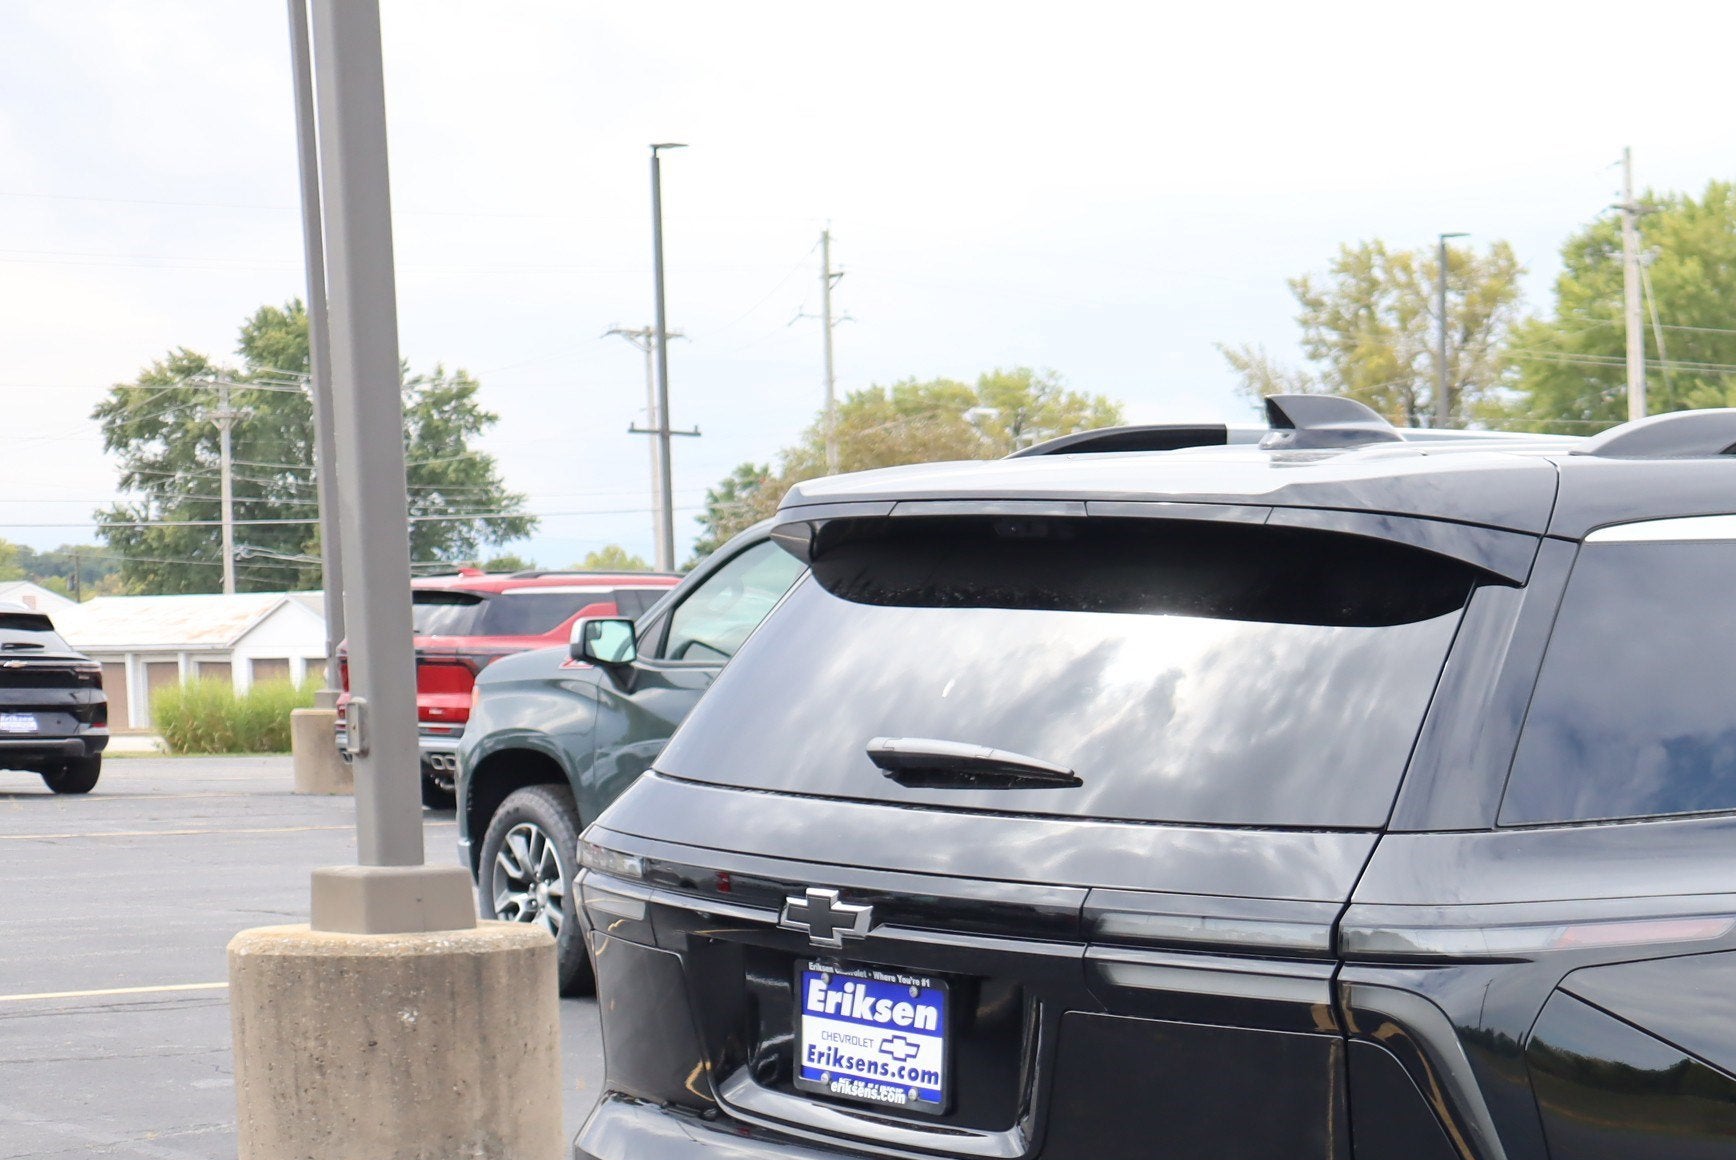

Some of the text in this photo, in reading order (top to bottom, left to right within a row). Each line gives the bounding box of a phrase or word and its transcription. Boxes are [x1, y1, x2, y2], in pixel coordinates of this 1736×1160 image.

[807, 978, 938, 1031] Eriksen
[821, 1030, 875, 1048] CHEVROLET
[807, 1044, 939, 1085] Eriksens.com
[830, 1080, 906, 1104] eriksens.com
